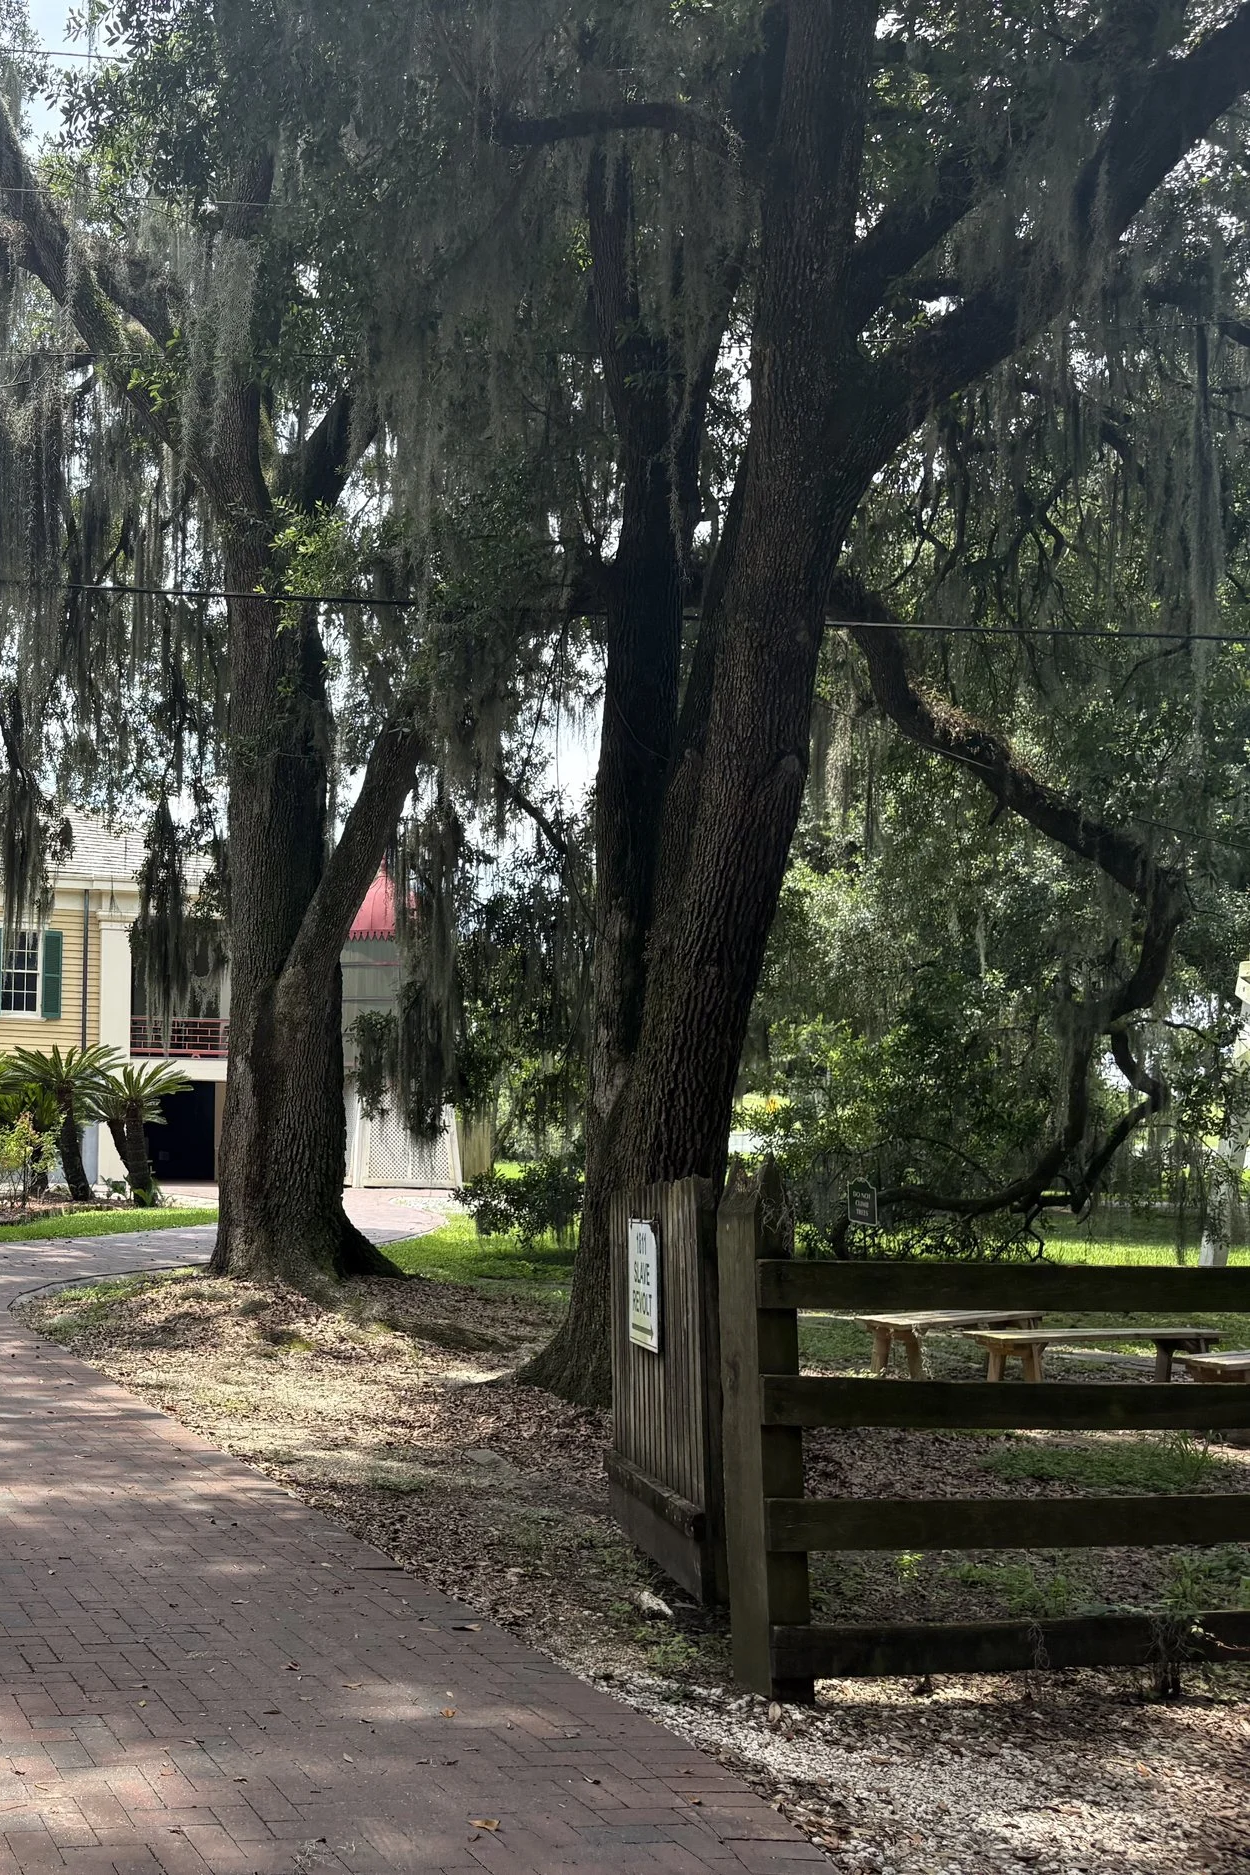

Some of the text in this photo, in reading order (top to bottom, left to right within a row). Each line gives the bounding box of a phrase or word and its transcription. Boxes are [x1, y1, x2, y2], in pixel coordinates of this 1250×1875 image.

[861, 1192, 871, 1200] NOT
[636, 1233, 646, 1255] 1811
[633, 1261, 650, 1285] SLAVE
[632, 1290, 652, 1317] REVOLT
